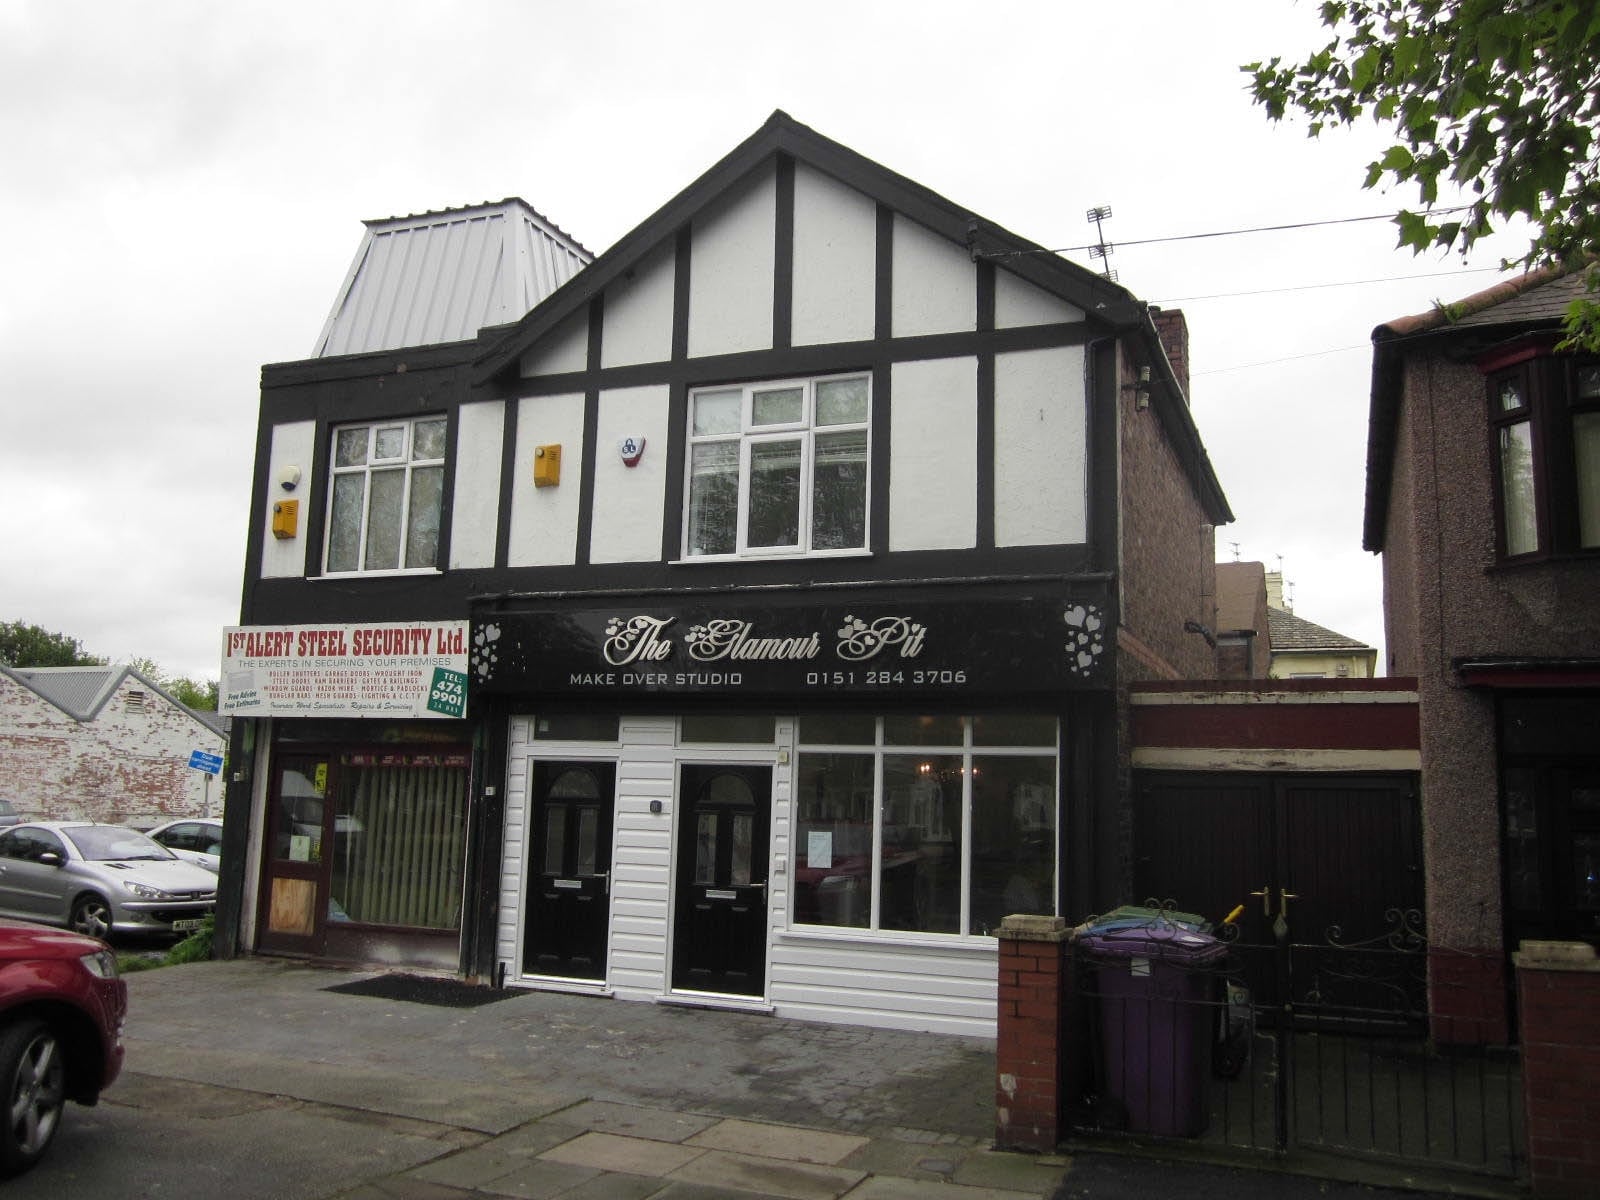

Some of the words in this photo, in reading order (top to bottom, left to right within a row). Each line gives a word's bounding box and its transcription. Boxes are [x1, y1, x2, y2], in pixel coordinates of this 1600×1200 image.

[246, 631, 294, 657] ALERT
[297, 630, 347, 657] STEEL
[352, 628, 432, 656] SECURITY
[437, 627, 467, 655] Ltd.
[603, 615, 676, 666] The
[688, 619, 821, 662] Glamour
[836, 616, 928, 661] Pit
[239, 659, 256, 668] THE
[258, 659, 299, 668] EXPERTS
[301, 659, 311, 667] IN
[315, 658, 364, 667] SECURING
[368, 658, 397, 667] YOUR
[400, 657, 451, 666] PREMISES
[444, 672, 463, 684] TEL:
[570, 673, 616, 685] MAKE
[622, 673, 668, 685] OVER
[675, 672, 742, 685] STUDIO
[806, 672, 855, 685] 0151
[865, 671, 905, 684] 284
[913, 670, 966, 684] 3706
[437, 681, 462, 695] 474
[432, 690, 462, 706] 9901
